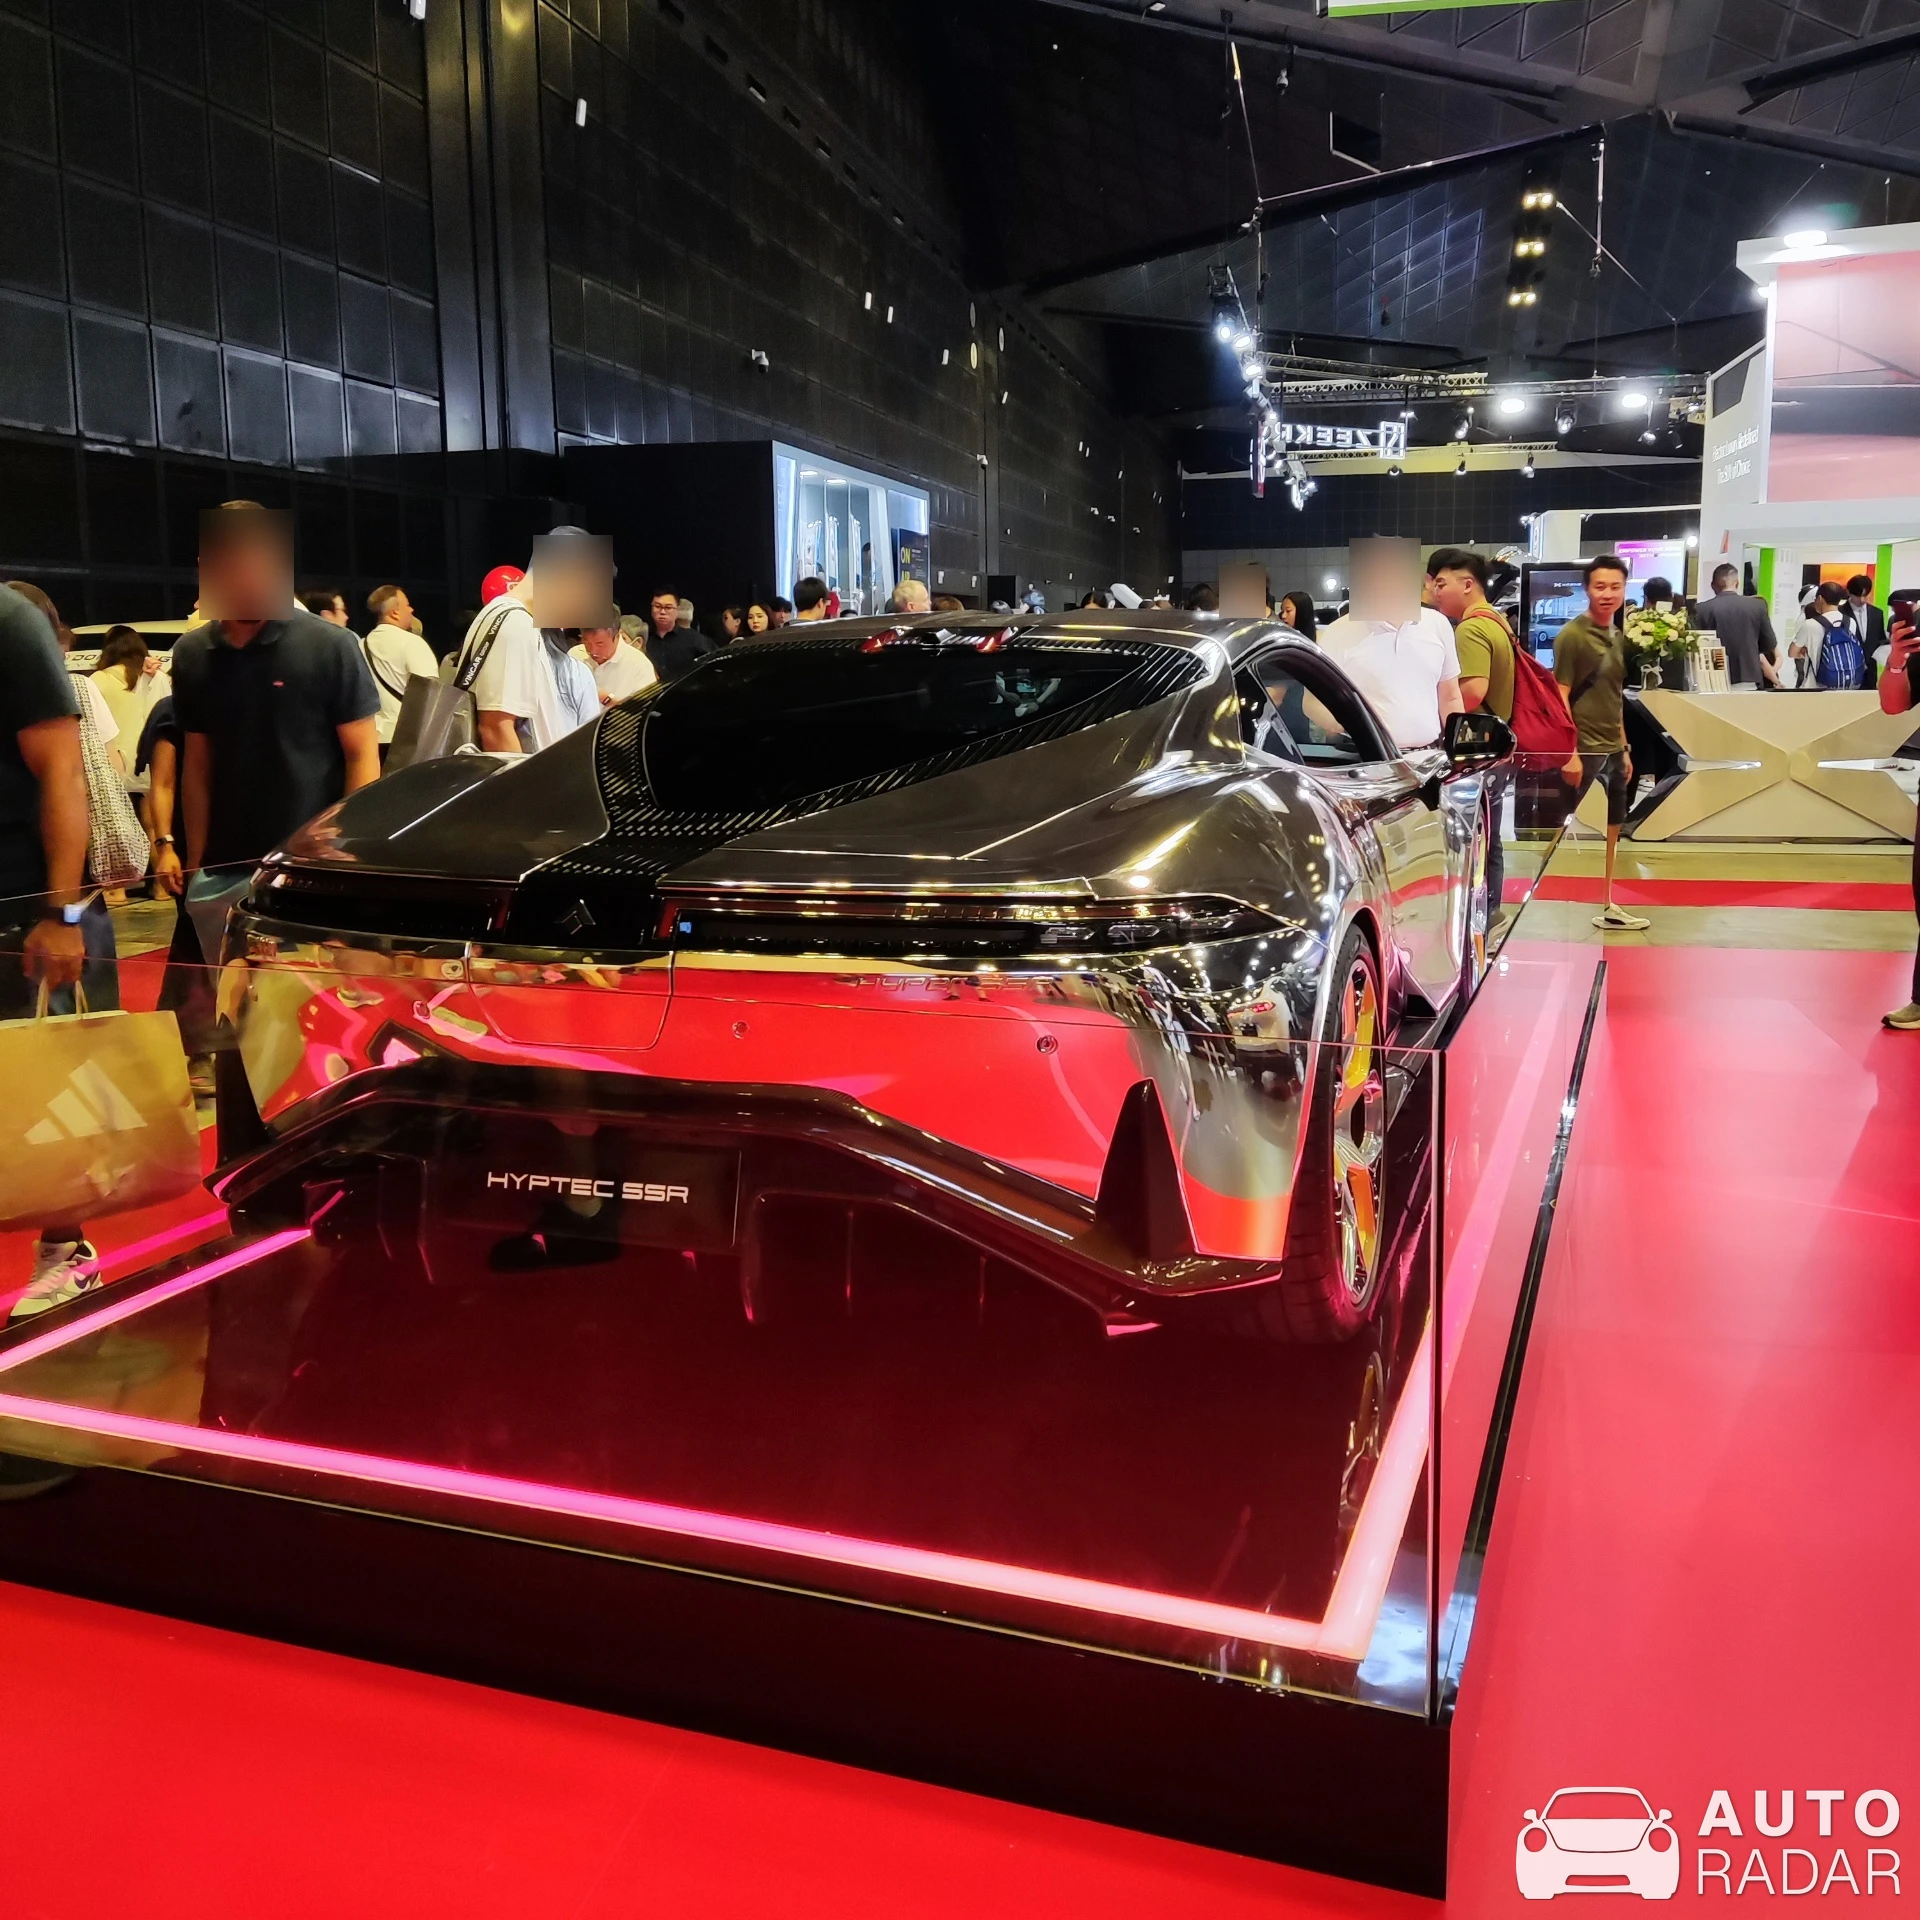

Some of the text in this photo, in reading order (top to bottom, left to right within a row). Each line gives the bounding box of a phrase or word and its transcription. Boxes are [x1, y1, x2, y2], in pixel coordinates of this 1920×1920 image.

[901, 546, 911, 564] ON
[488, 614, 505, 635] VINC
[462, 656, 483, 686] VINCAR
[487, 1171, 689, 1203] HYPTEC SSR
